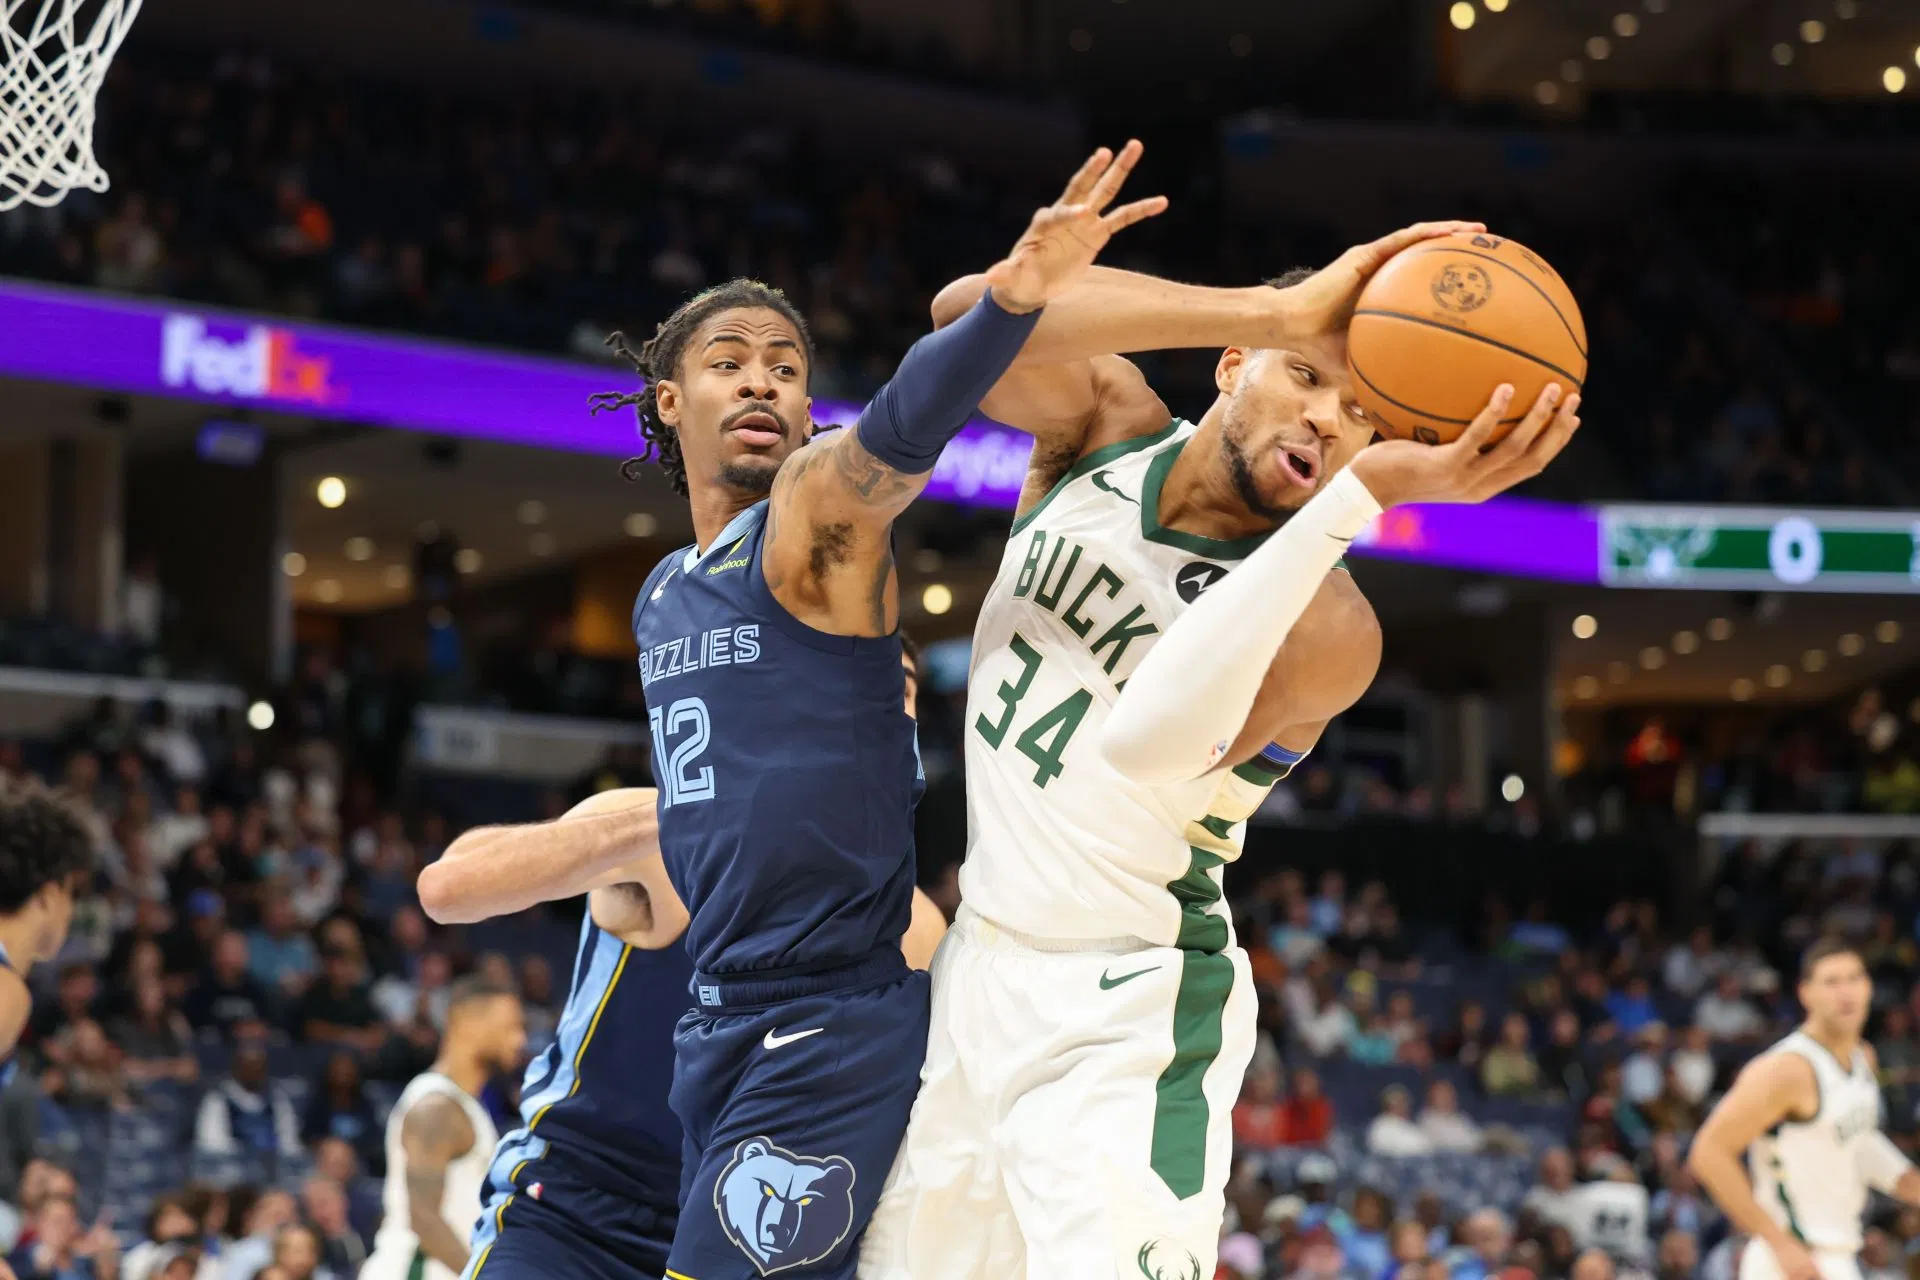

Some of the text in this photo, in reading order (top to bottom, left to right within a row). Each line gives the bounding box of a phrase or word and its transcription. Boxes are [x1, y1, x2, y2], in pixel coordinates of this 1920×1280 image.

[163, 313, 331, 402] FedEx
[1768, 517, 1823, 585] 0
[638, 624, 761, 690] RIZZLIES
[1013, 530, 1160, 694] BUCK
[650, 696, 715, 810] 12
[975, 631, 1094, 789] 34
